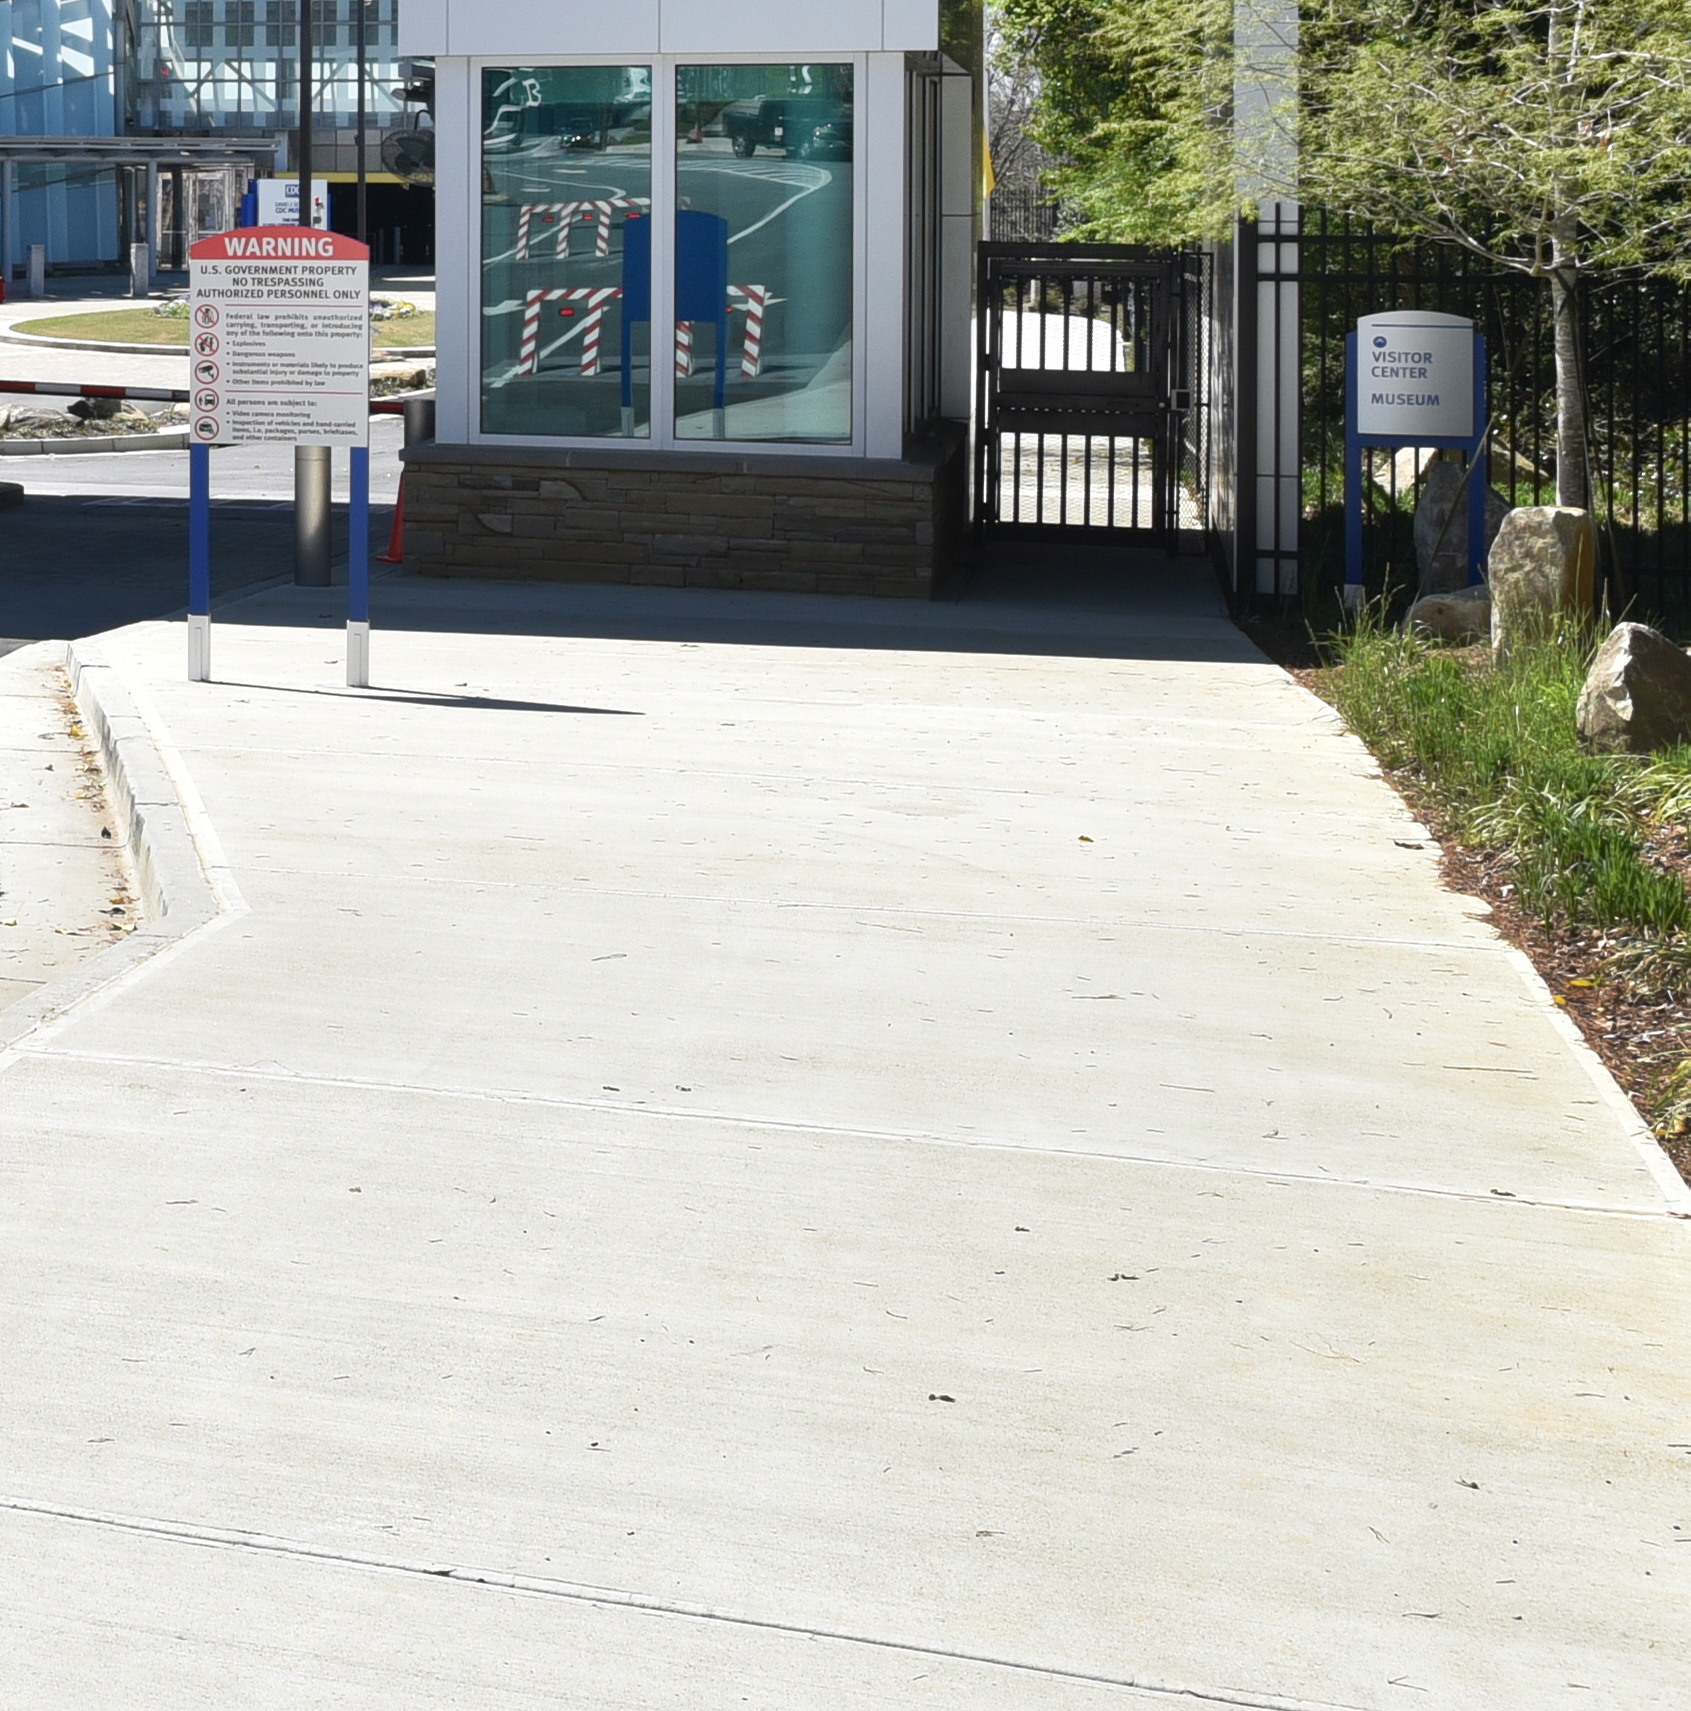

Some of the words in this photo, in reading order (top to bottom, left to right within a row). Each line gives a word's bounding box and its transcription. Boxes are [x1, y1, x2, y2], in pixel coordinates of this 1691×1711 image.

[224, 237, 334, 257] WARNING
[200, 265, 222, 275] U.S.
[225, 265, 298, 275] GOVERNMENT
[301, 266, 357, 276] PROPERTY
[232, 277, 248, 286] NO
[250, 277, 324, 287] TRESPASSING
[197, 289, 264, 299] AUTHORIZED
[267, 289, 330, 299] PERSONNEL
[333, 290, 361, 299] ONLY
[262, 330, 295, 338] following
[1372, 351, 1433, 364] VISITOR
[269, 369, 287, 377] injury
[1371, 366, 1428, 379] CENTER
[280, 399, 305, 408] subject
[1371, 393, 1440, 406] MUSEUM
[276, 411, 311, 419] monitoring
[323, 428, 358, 436] briefcases,
